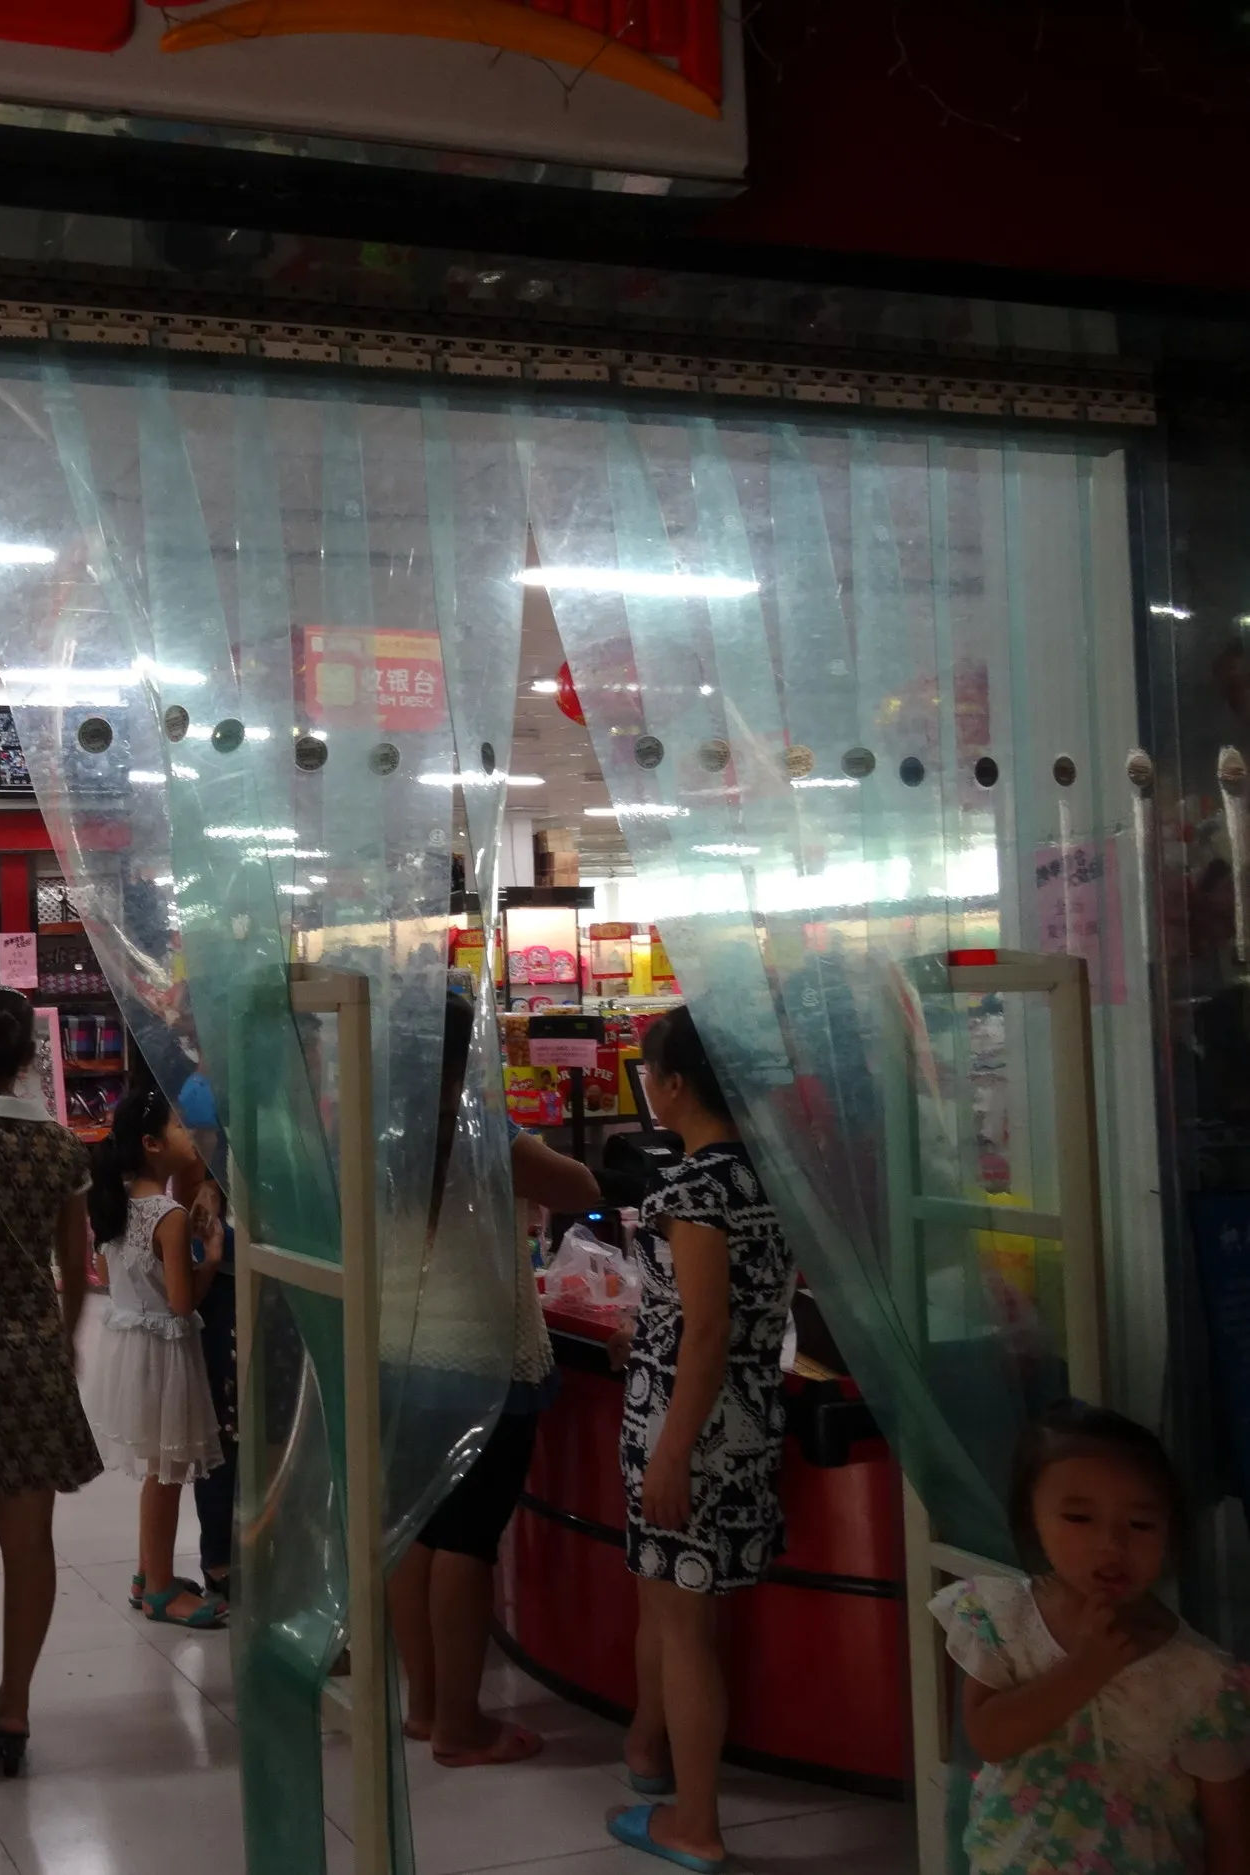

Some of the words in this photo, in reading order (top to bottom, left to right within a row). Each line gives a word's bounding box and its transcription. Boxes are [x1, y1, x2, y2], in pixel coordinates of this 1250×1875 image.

[361, 667, 436, 695] 收银台
[593, 1067, 615, 1082] PIE
